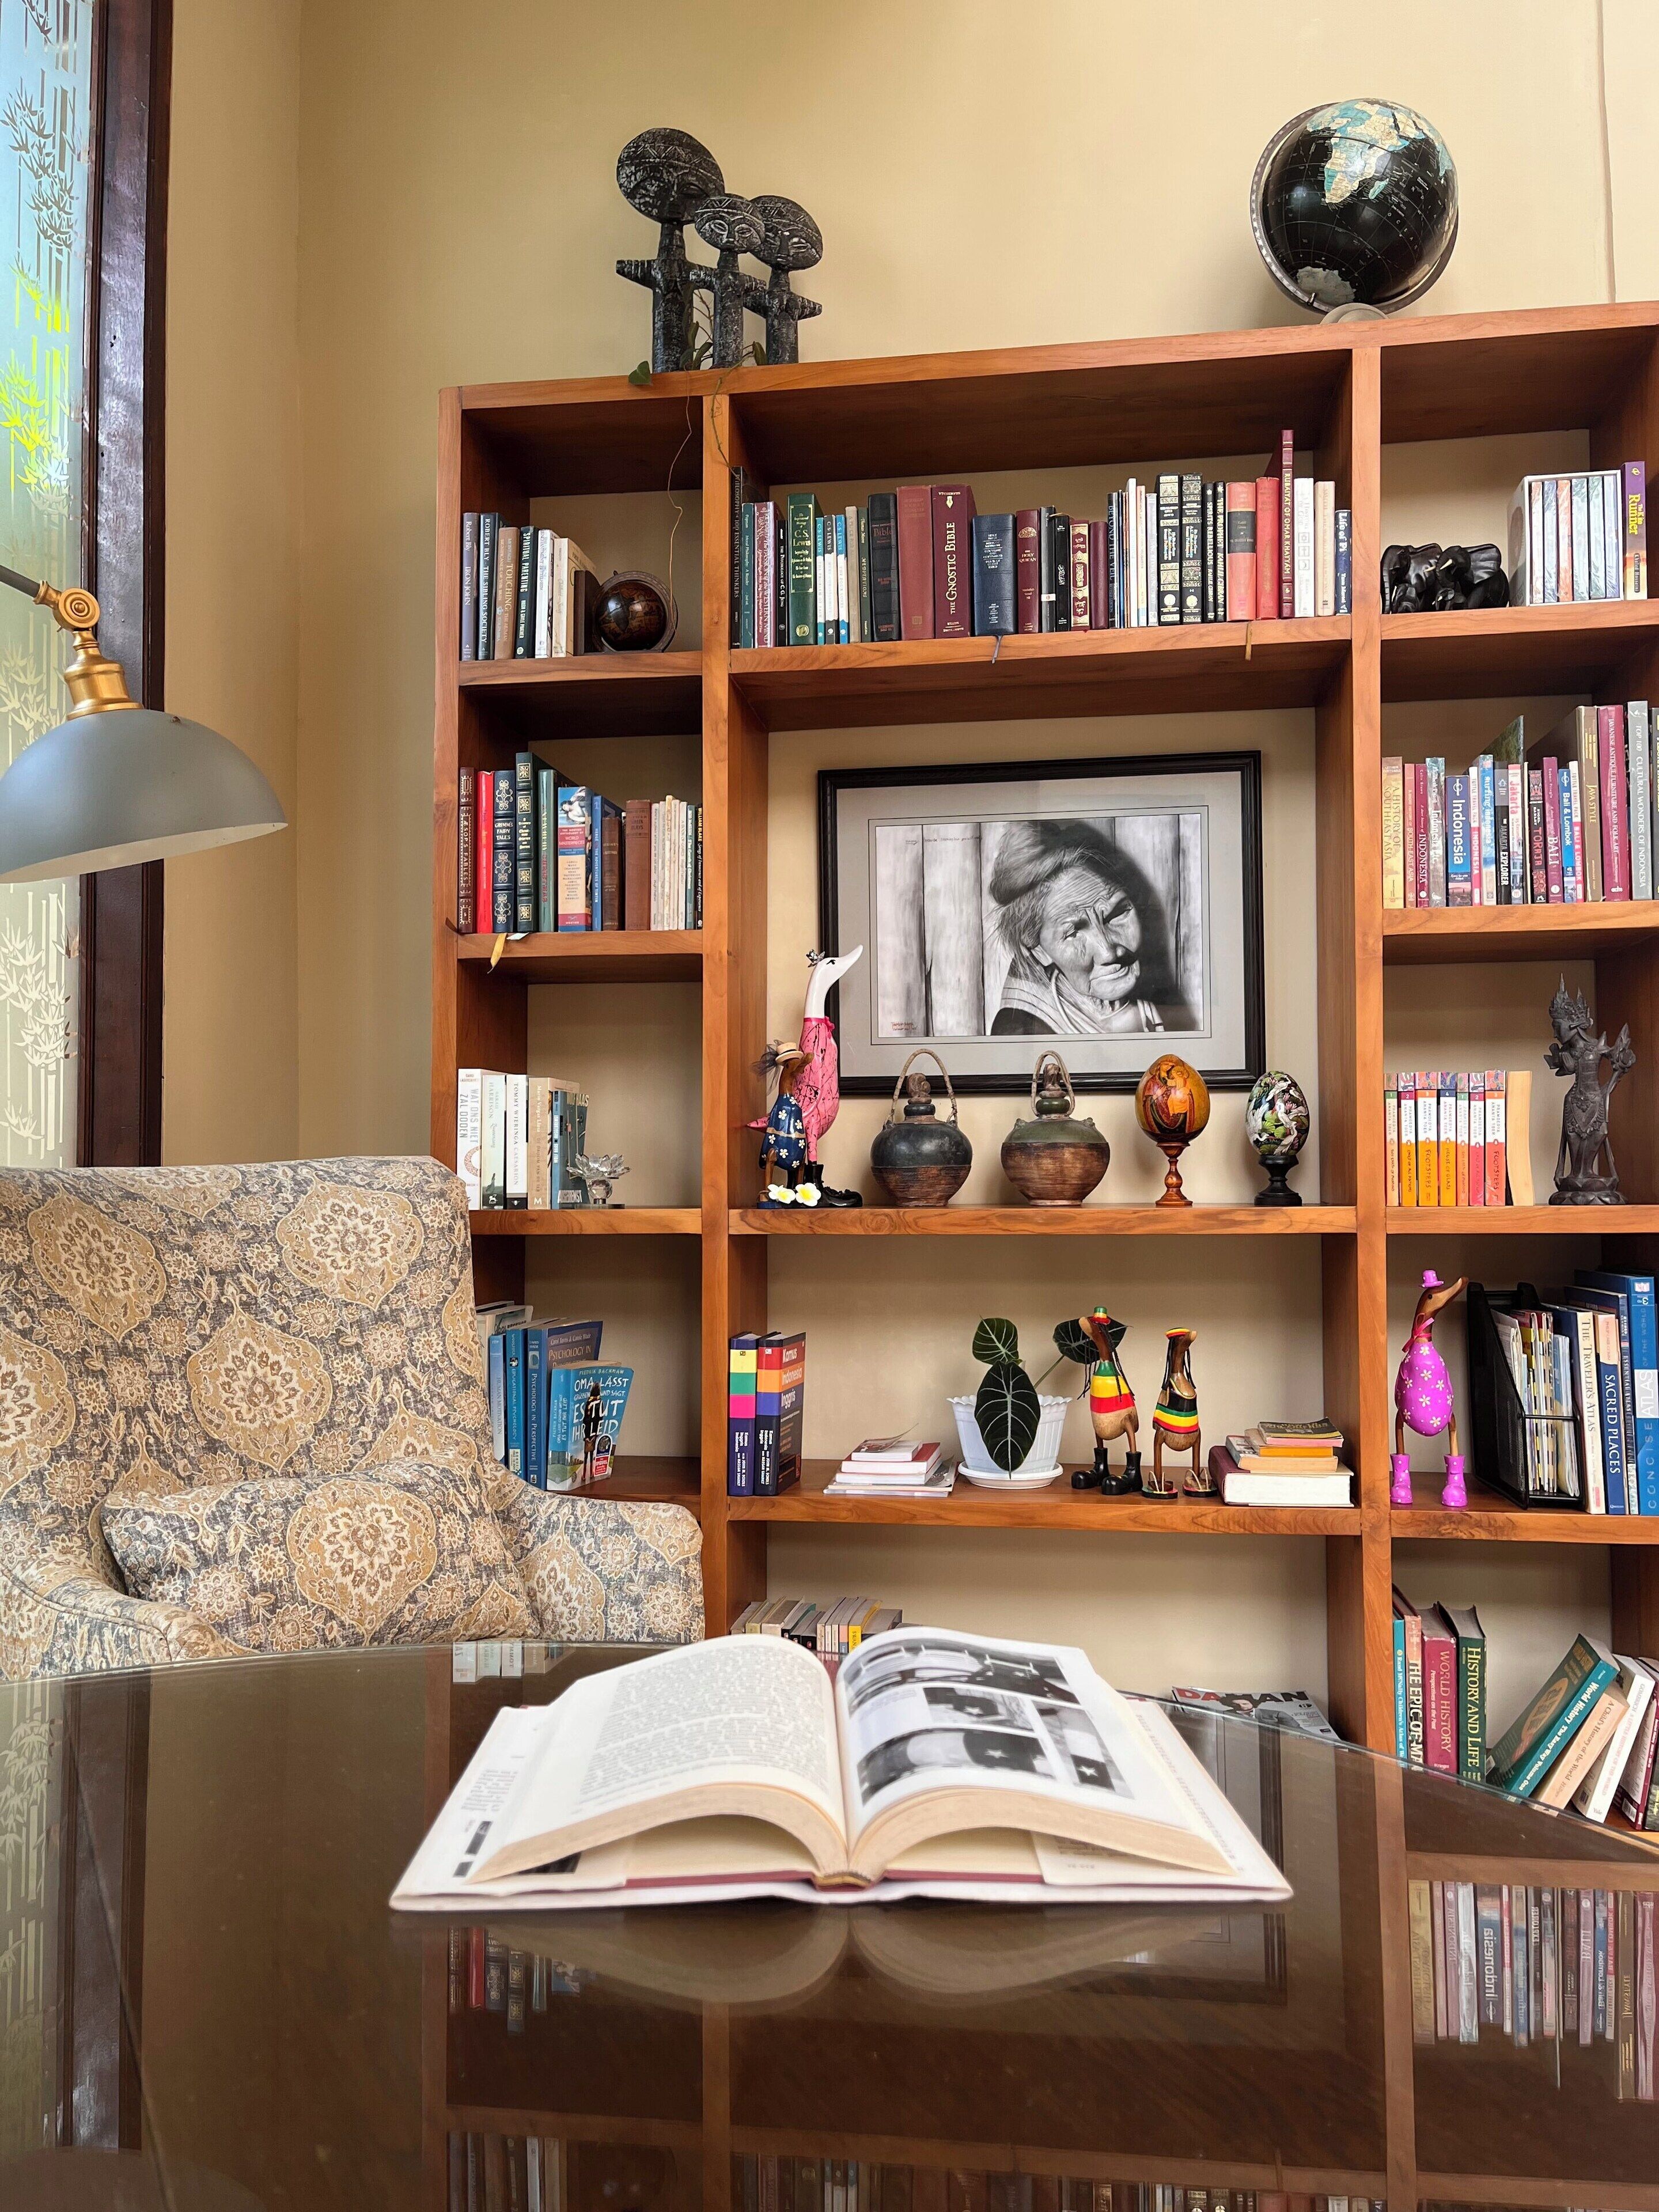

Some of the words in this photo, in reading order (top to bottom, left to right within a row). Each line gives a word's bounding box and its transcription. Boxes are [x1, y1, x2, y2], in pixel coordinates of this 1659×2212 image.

[1284, 507, 1291, 516] OF
[1338, 512, 1348, 530] Life
[1628, 494, 1641, 535] Runner
[521, 532, 531, 560] SPIRITUAL
[945, 522, 956, 552] BIBLE
[1338, 531, 1347, 540] of
[1339, 542, 1347, 552] Pi
[520, 562, 529, 592] PARENTING
[945, 554, 957, 601] GNOSTIC
[1635, 756, 1643, 796] CULTURAL
[1483, 777, 1493, 807] surfing
[1510, 781, 1520, 815] Jakarta
[1562, 792, 1570, 806] Bali
[1586, 784, 1597, 801] JAVA
[1384, 787, 1392, 839] SOUTHEAST
[1392, 795, 1400, 834] HISTORY
[1431, 809, 1442, 847] Indonesia
[1452, 800, 1467, 864] Indonesia
[1563, 816, 1572, 846] Lombok
[1384, 840, 1392, 861] ASIA
[1392, 836, 1400, 848] OF
[1533, 827, 1543, 866] TORAJA
[1547, 835, 1559, 865] BALI
[1638, 836, 1645, 846] OF
[1418, 834, 1427, 883] INDONESIA
[1500, 851, 1509, 885] EXPLORER
[1638, 847, 1646, 887] INDONESIA
[460, 1094, 468, 1108] ZAL
[470, 1089, 479, 1104] WAT
[459, 1111, 468, 1138] DODEN
[470, 1107, 479, 1123] ONS
[470, 1127, 478, 1143] NIET
[1581, 1319, 1591, 1341] THE
[549, 1347, 584, 1361] PSYCHOLOGY
[782, 1348, 797, 1363] Kamus
[575, 1377, 593, 1392] OMA
[600, 1376, 629, 1388] LÄSST
[782, 1367, 803, 1385] Indonesia
[1582, 1344, 1595, 1399] TRAVELER'S
[781, 1389, 796, 1410] Inggris
[1605, 1374, 1618, 1424] SACRED
[1639, 1370, 1654, 1417] ATLAS
[573, 1402, 585, 1423] ES
[589, 1399, 624, 1418] TUT
[1586, 1401, 1596, 1432] ATLAS
[572, 1423, 586, 1442] IHR
[590, 1419, 619, 1437] LEID
[1608, 1429, 1620, 1474] PLACES
[1644, 1423, 1656, 1509] CONCISE
[1410, 1660, 1422, 1684] THE
[1440, 1651, 1450, 1696] WORLD
[1467, 1647, 1481, 1703] HISTORY
[1410, 1687, 1422, 1718] EPIC
[1581, 1681, 1599, 1702] World
[1467, 1703, 1480, 1734] AND
[1565, 1702, 1585, 1724] History
[1597, 1707, 1611, 1726] Child's
[1410, 1721, 1423, 1740] OF
[1440, 1700, 1451, 1753] HISTORY
[1558, 1725, 1568, 1736] The
[1584, 1725, 1600, 1746] History
[1467, 1737, 1482, 1767] LIFE
[1540, 1749, 1551, 1761] Way
[1582, 1745, 1588, 1755] of
[1566, 1763, 1578, 1781] World
